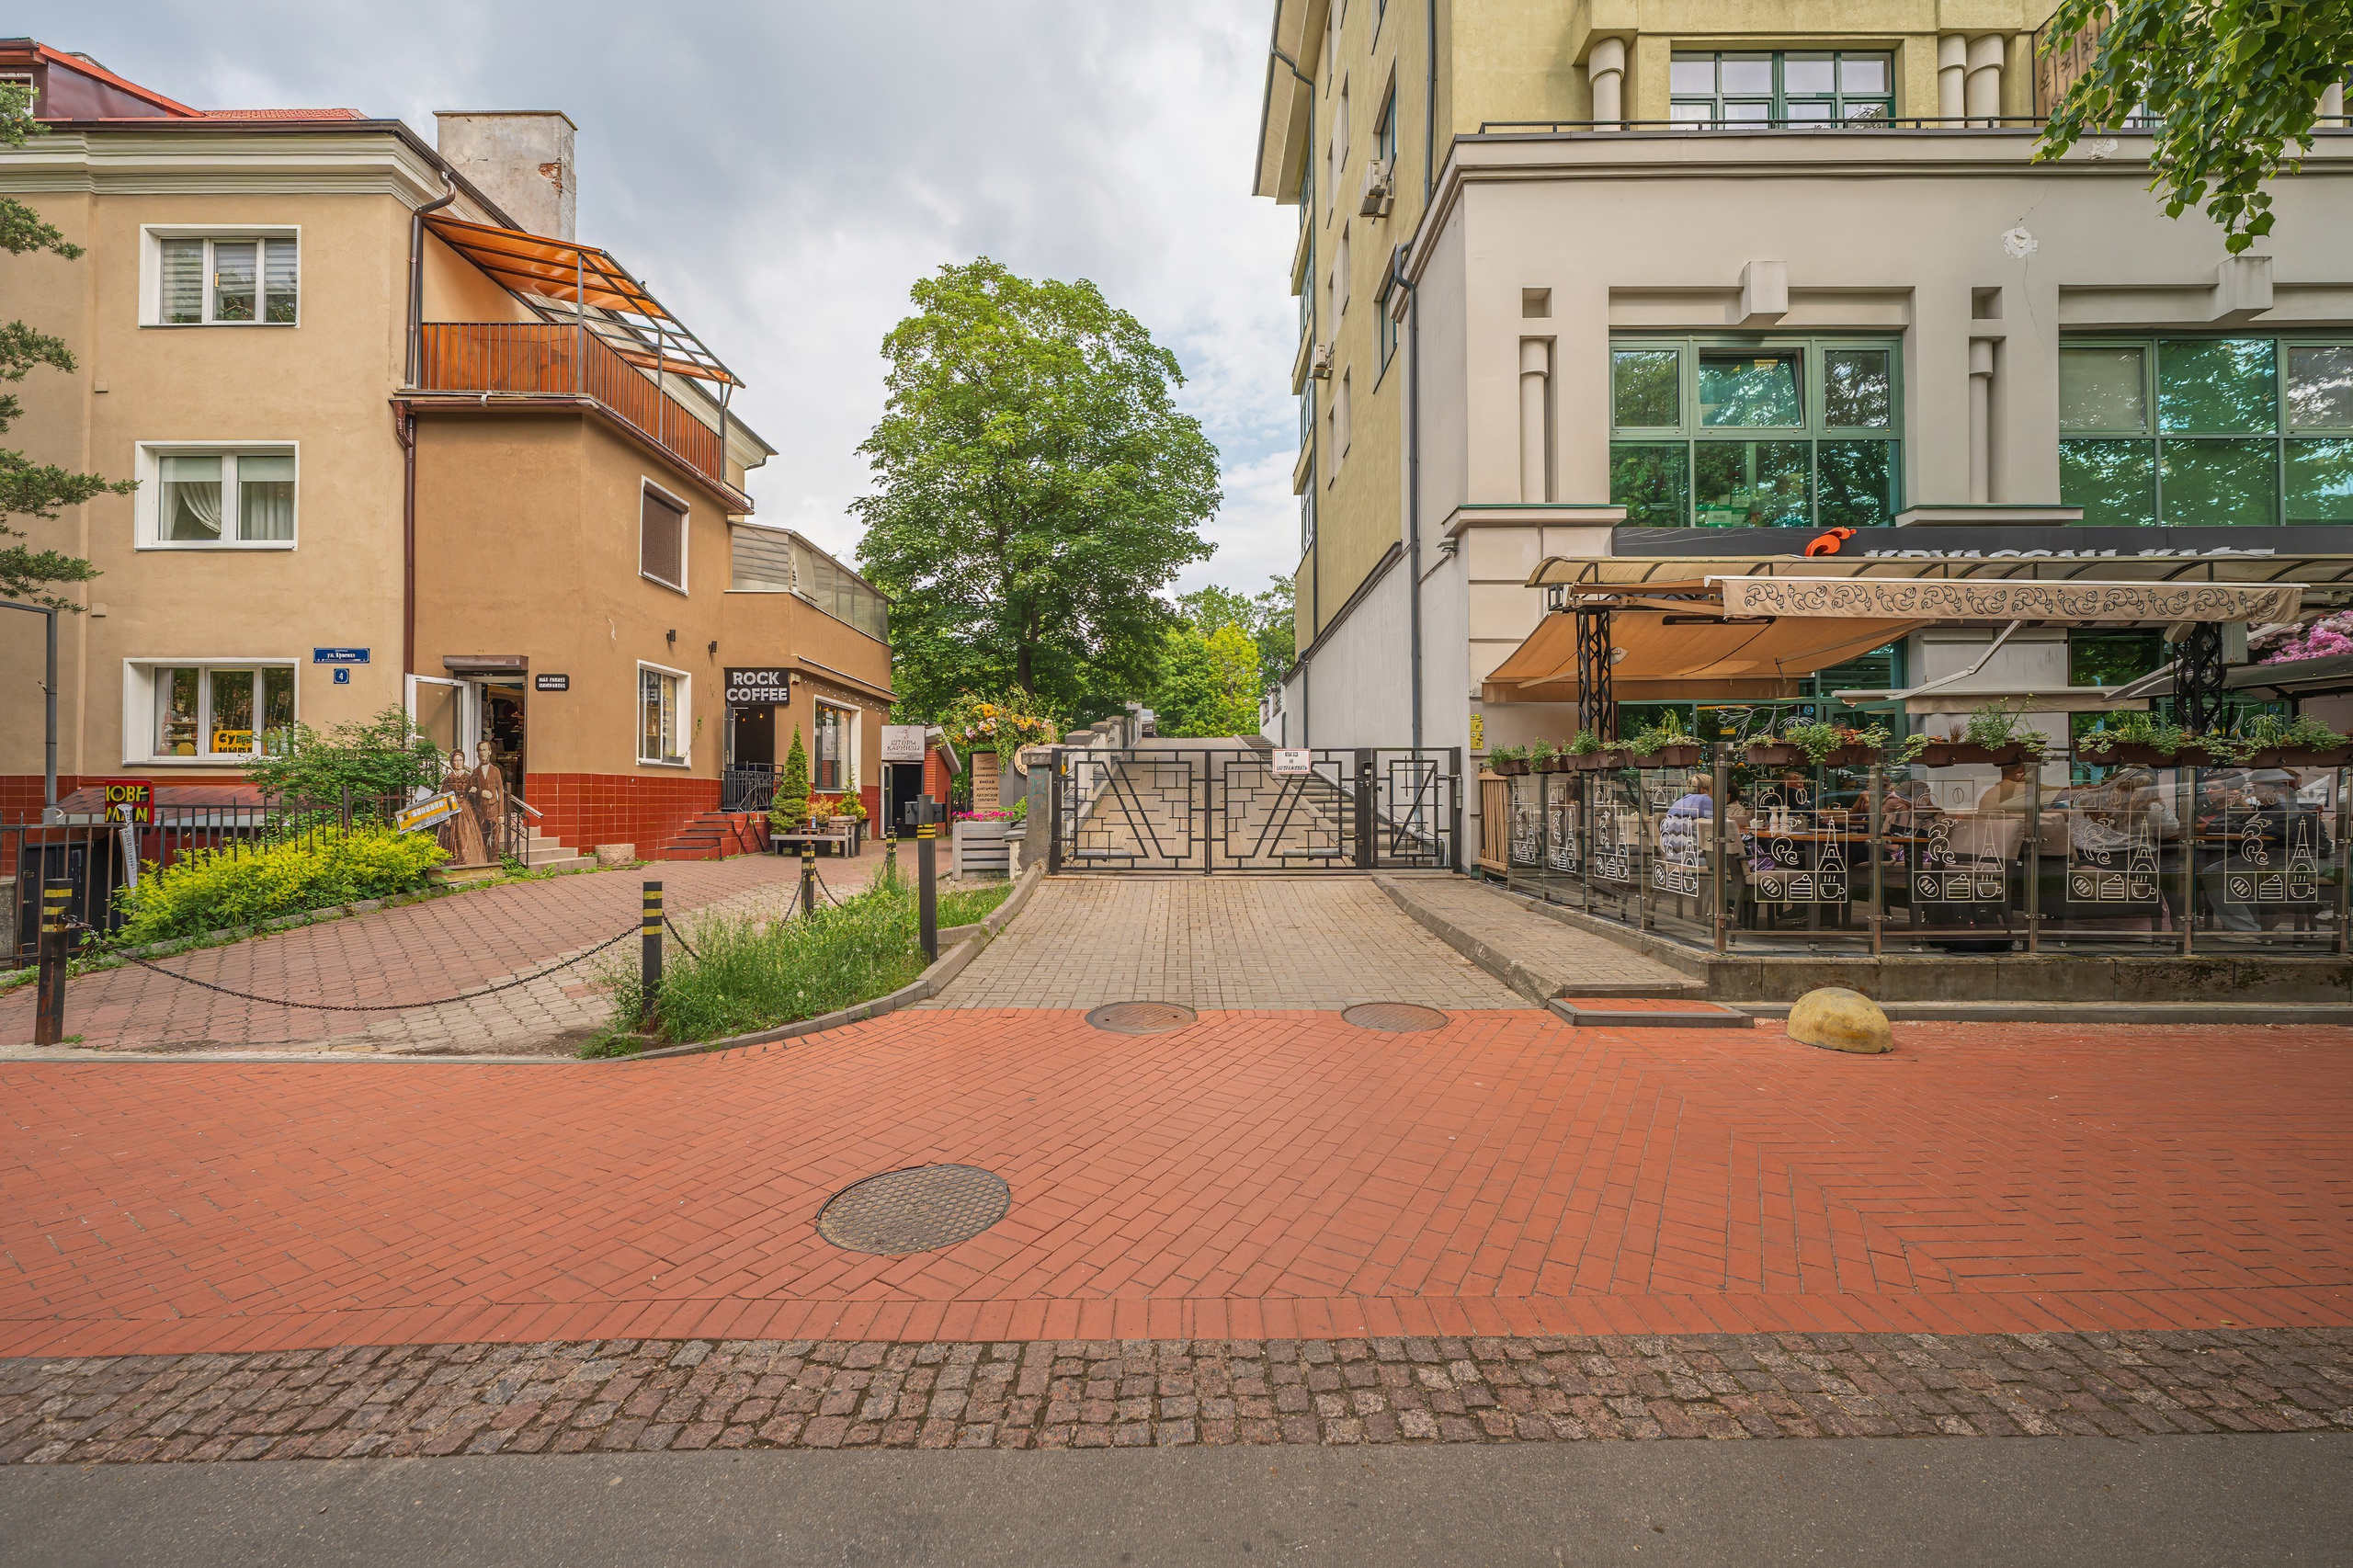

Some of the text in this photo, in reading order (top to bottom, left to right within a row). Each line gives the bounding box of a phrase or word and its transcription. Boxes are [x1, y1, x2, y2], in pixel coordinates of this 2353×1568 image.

[338, 672, 344, 680] 4
[733, 671, 780, 686] ROCK
[725, 687, 788, 702] COFFEE
